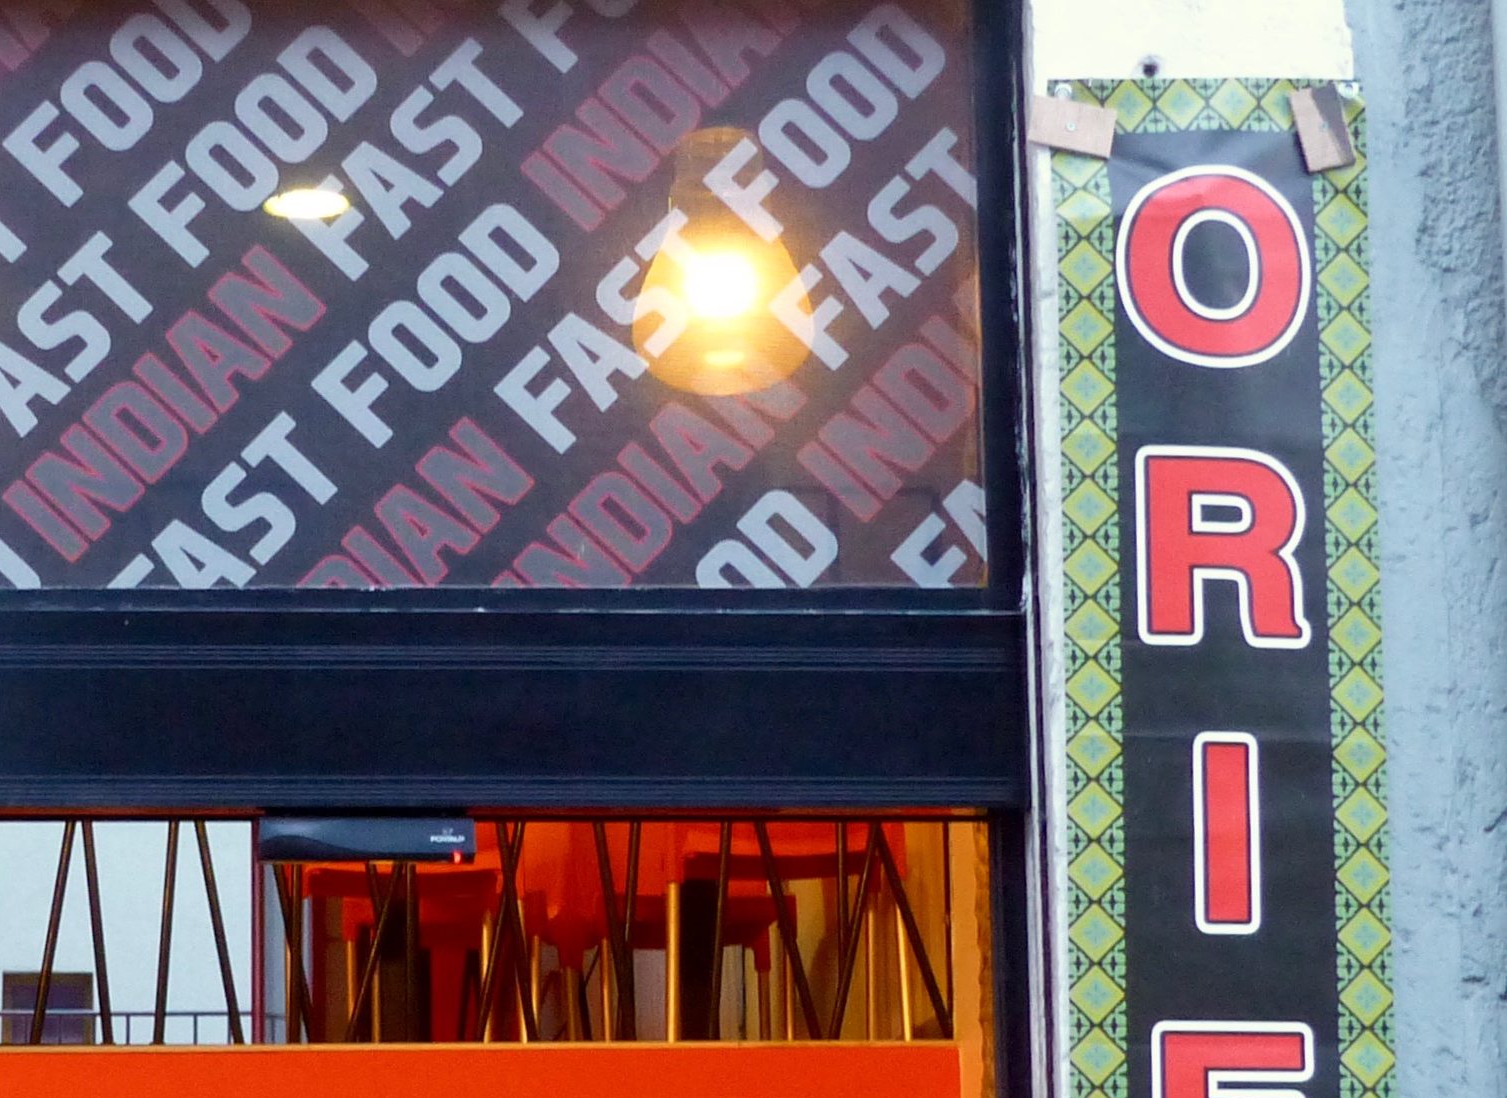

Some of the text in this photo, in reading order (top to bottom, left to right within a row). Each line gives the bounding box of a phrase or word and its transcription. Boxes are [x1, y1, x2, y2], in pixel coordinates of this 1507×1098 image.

[1, 0, 252, 208] FOOD
[3, 37, 524, 563] INDIAN FAST
[128, 25, 377, 268] FOOD
[311, 203, 559, 448] FOOD
[520, 0, 799, 233] INDIA
[494, 208, 699, 454] FAST
[702, 3, 946, 245] FOOD
[492, 370, 808, 588] NDIAN
[768, 127, 977, 372] FAST
[796, 315, 979, 522] INDI
